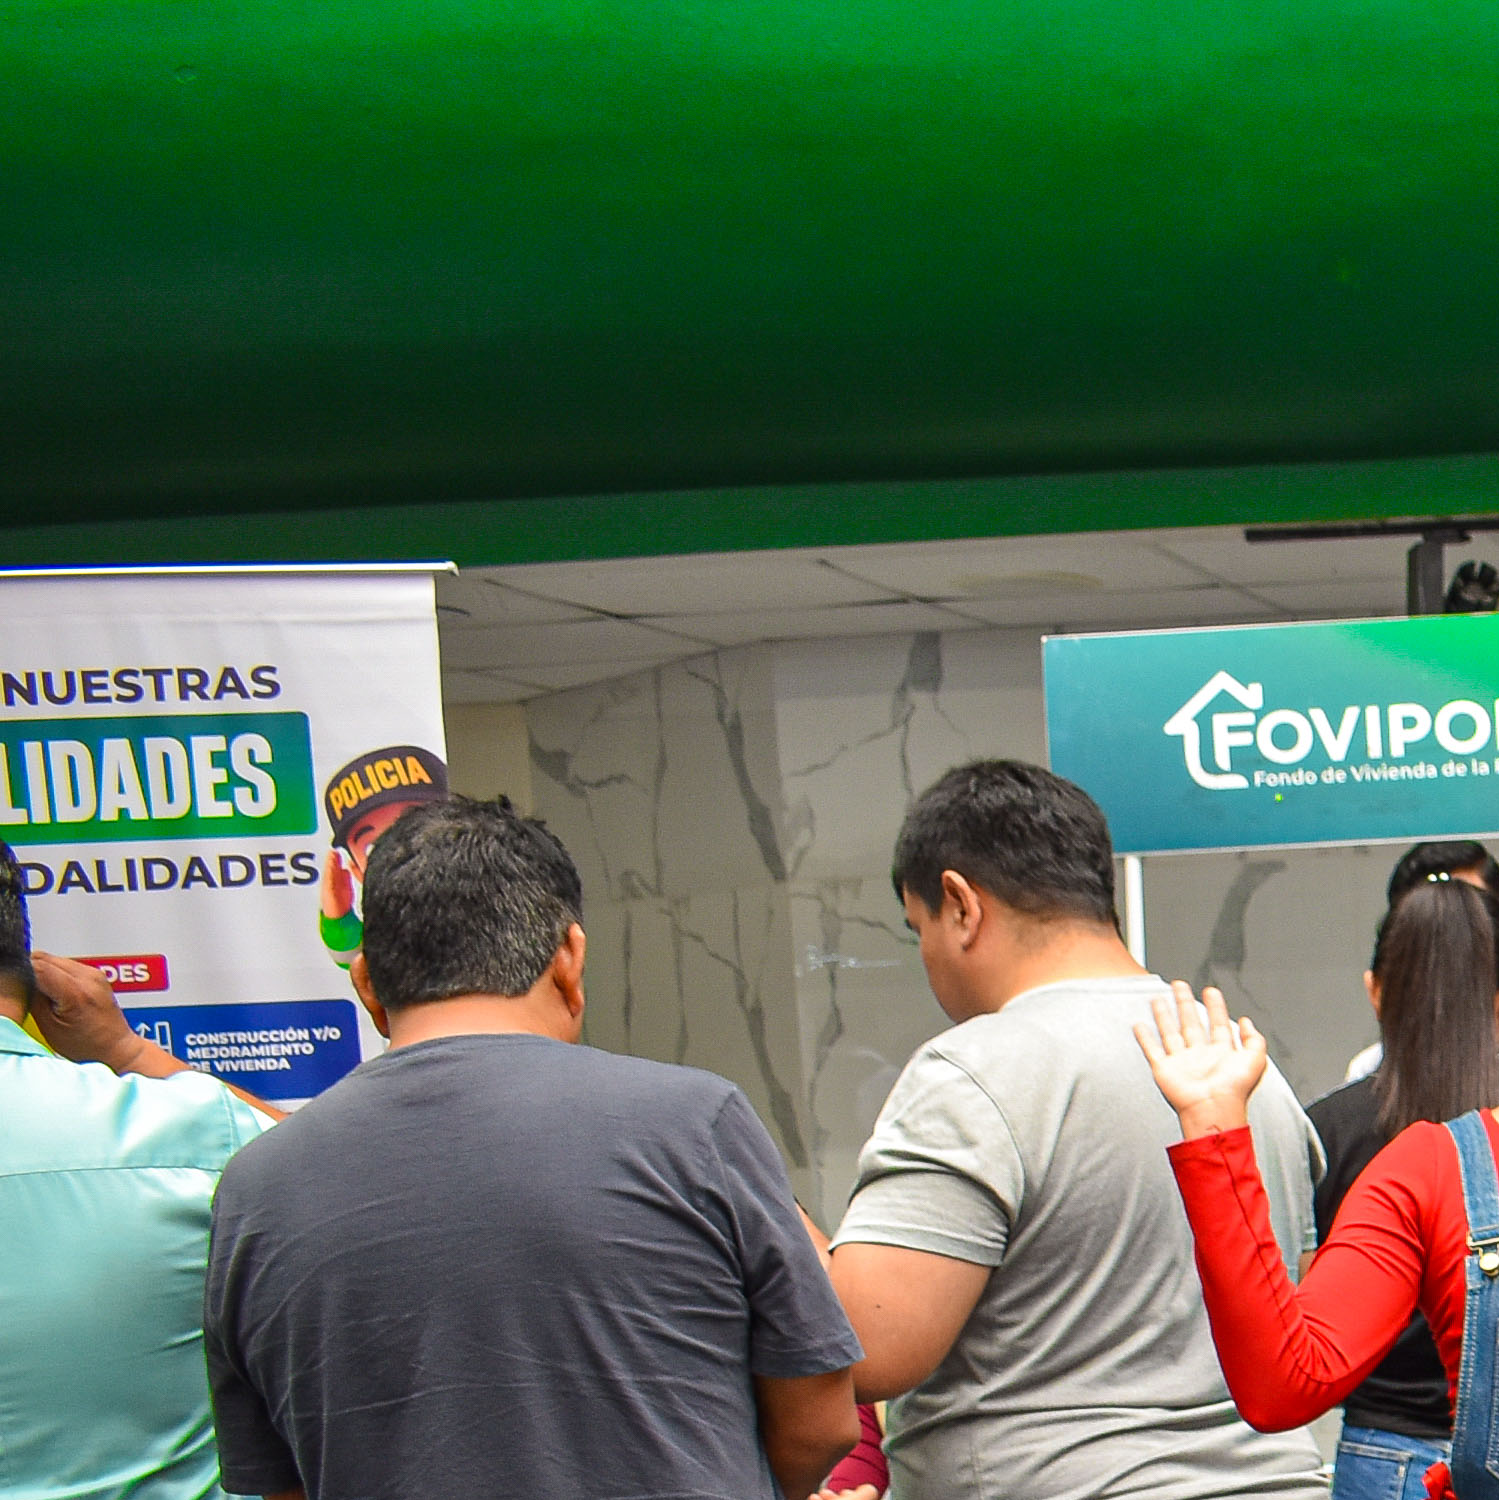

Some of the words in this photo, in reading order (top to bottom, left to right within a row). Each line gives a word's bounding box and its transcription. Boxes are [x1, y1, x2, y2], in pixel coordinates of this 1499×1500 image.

[2, 665, 281, 706] NUESTRAS
[1254, 767, 1318, 787] Fondo
[1321, 766, 1347, 784] de
[1350, 761, 1438, 782] Vivienda
[1441, 759, 1468, 778] de
[1471, 758, 1490, 776] la
[329, 755, 432, 820] POLICIA
[186, 1027, 310, 1045] CONSTRUCCIÓN
[313, 1025, 341, 1042] Y/O
[186, 1042, 315, 1060] MEJORAMIENTO
[215, 1057, 291, 1072] VIVIENDA
